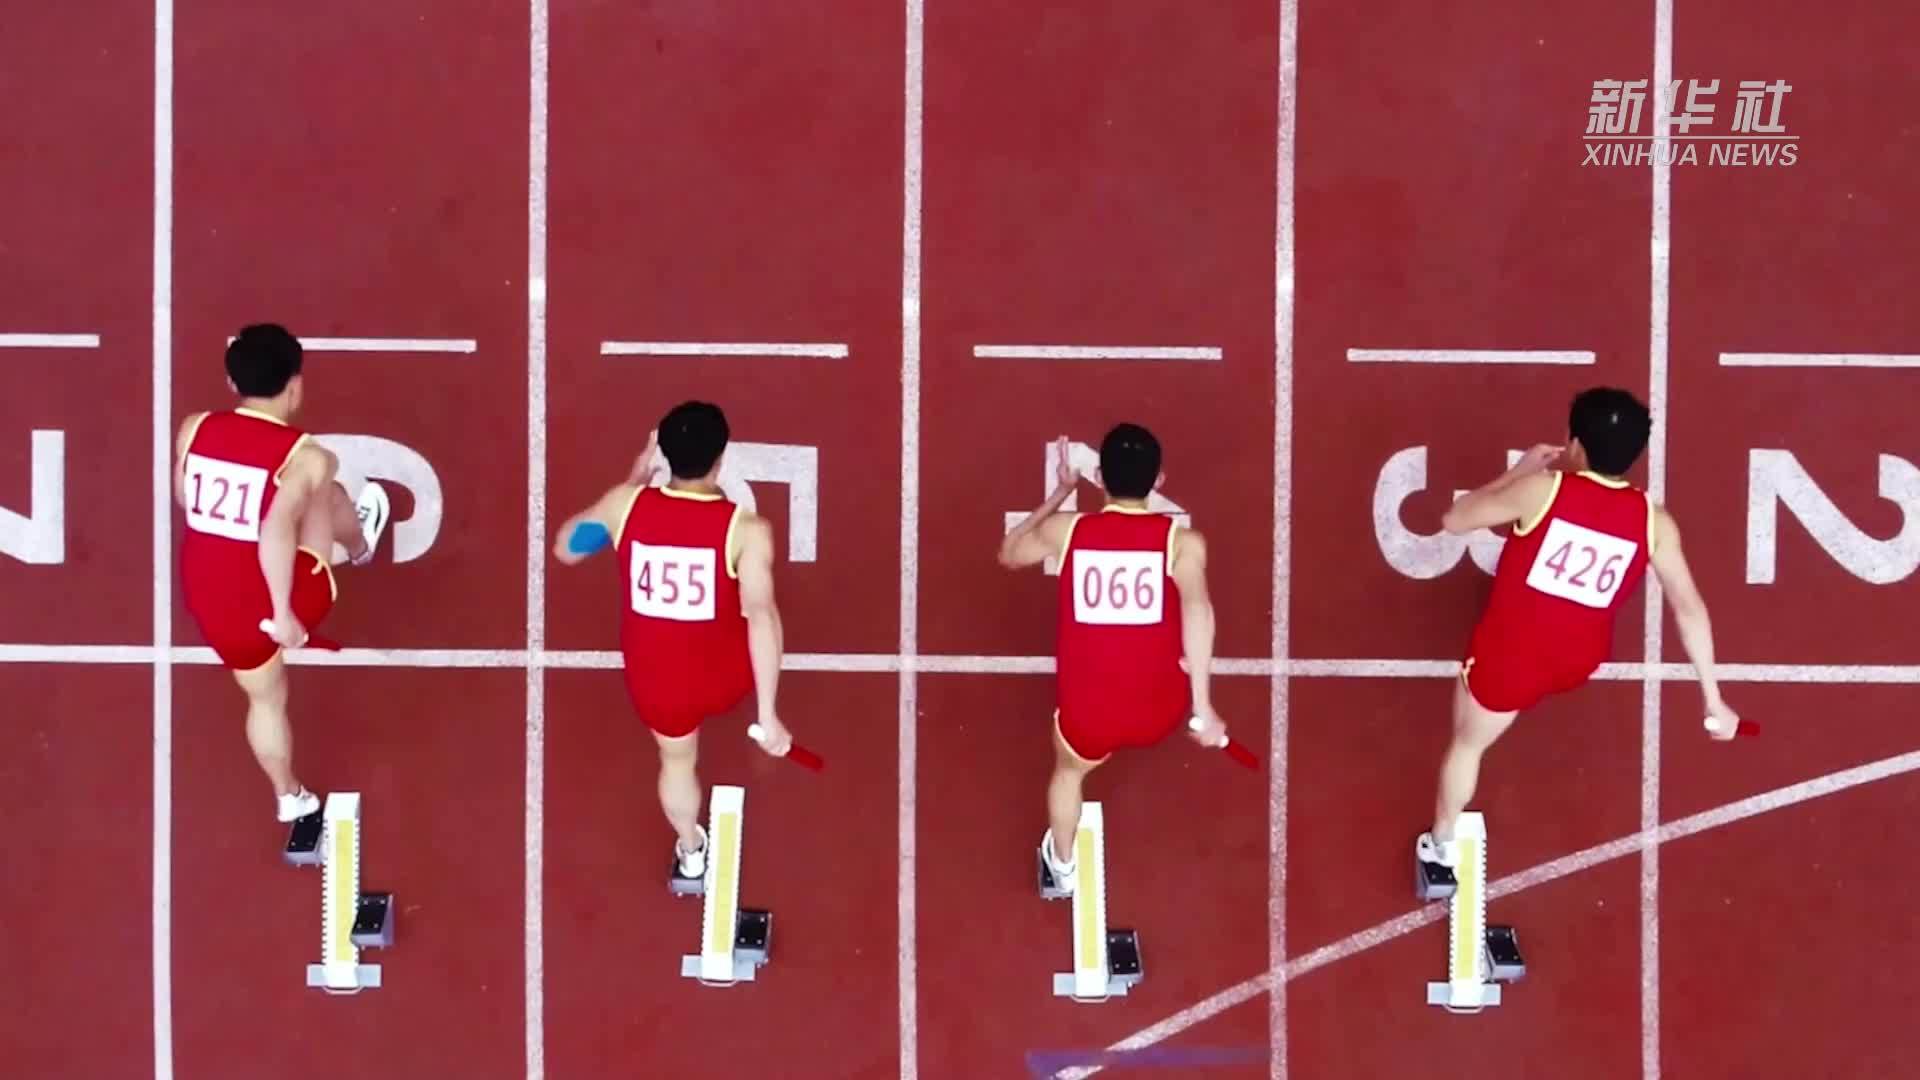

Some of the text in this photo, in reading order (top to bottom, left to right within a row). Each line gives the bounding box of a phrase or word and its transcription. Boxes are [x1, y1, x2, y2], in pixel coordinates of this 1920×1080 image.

[190, 472, 251, 526] 121
[637, 559, 706, 606] 455
[1082, 565, 1155, 610] 066
[1544, 540, 1623, 593] 426
